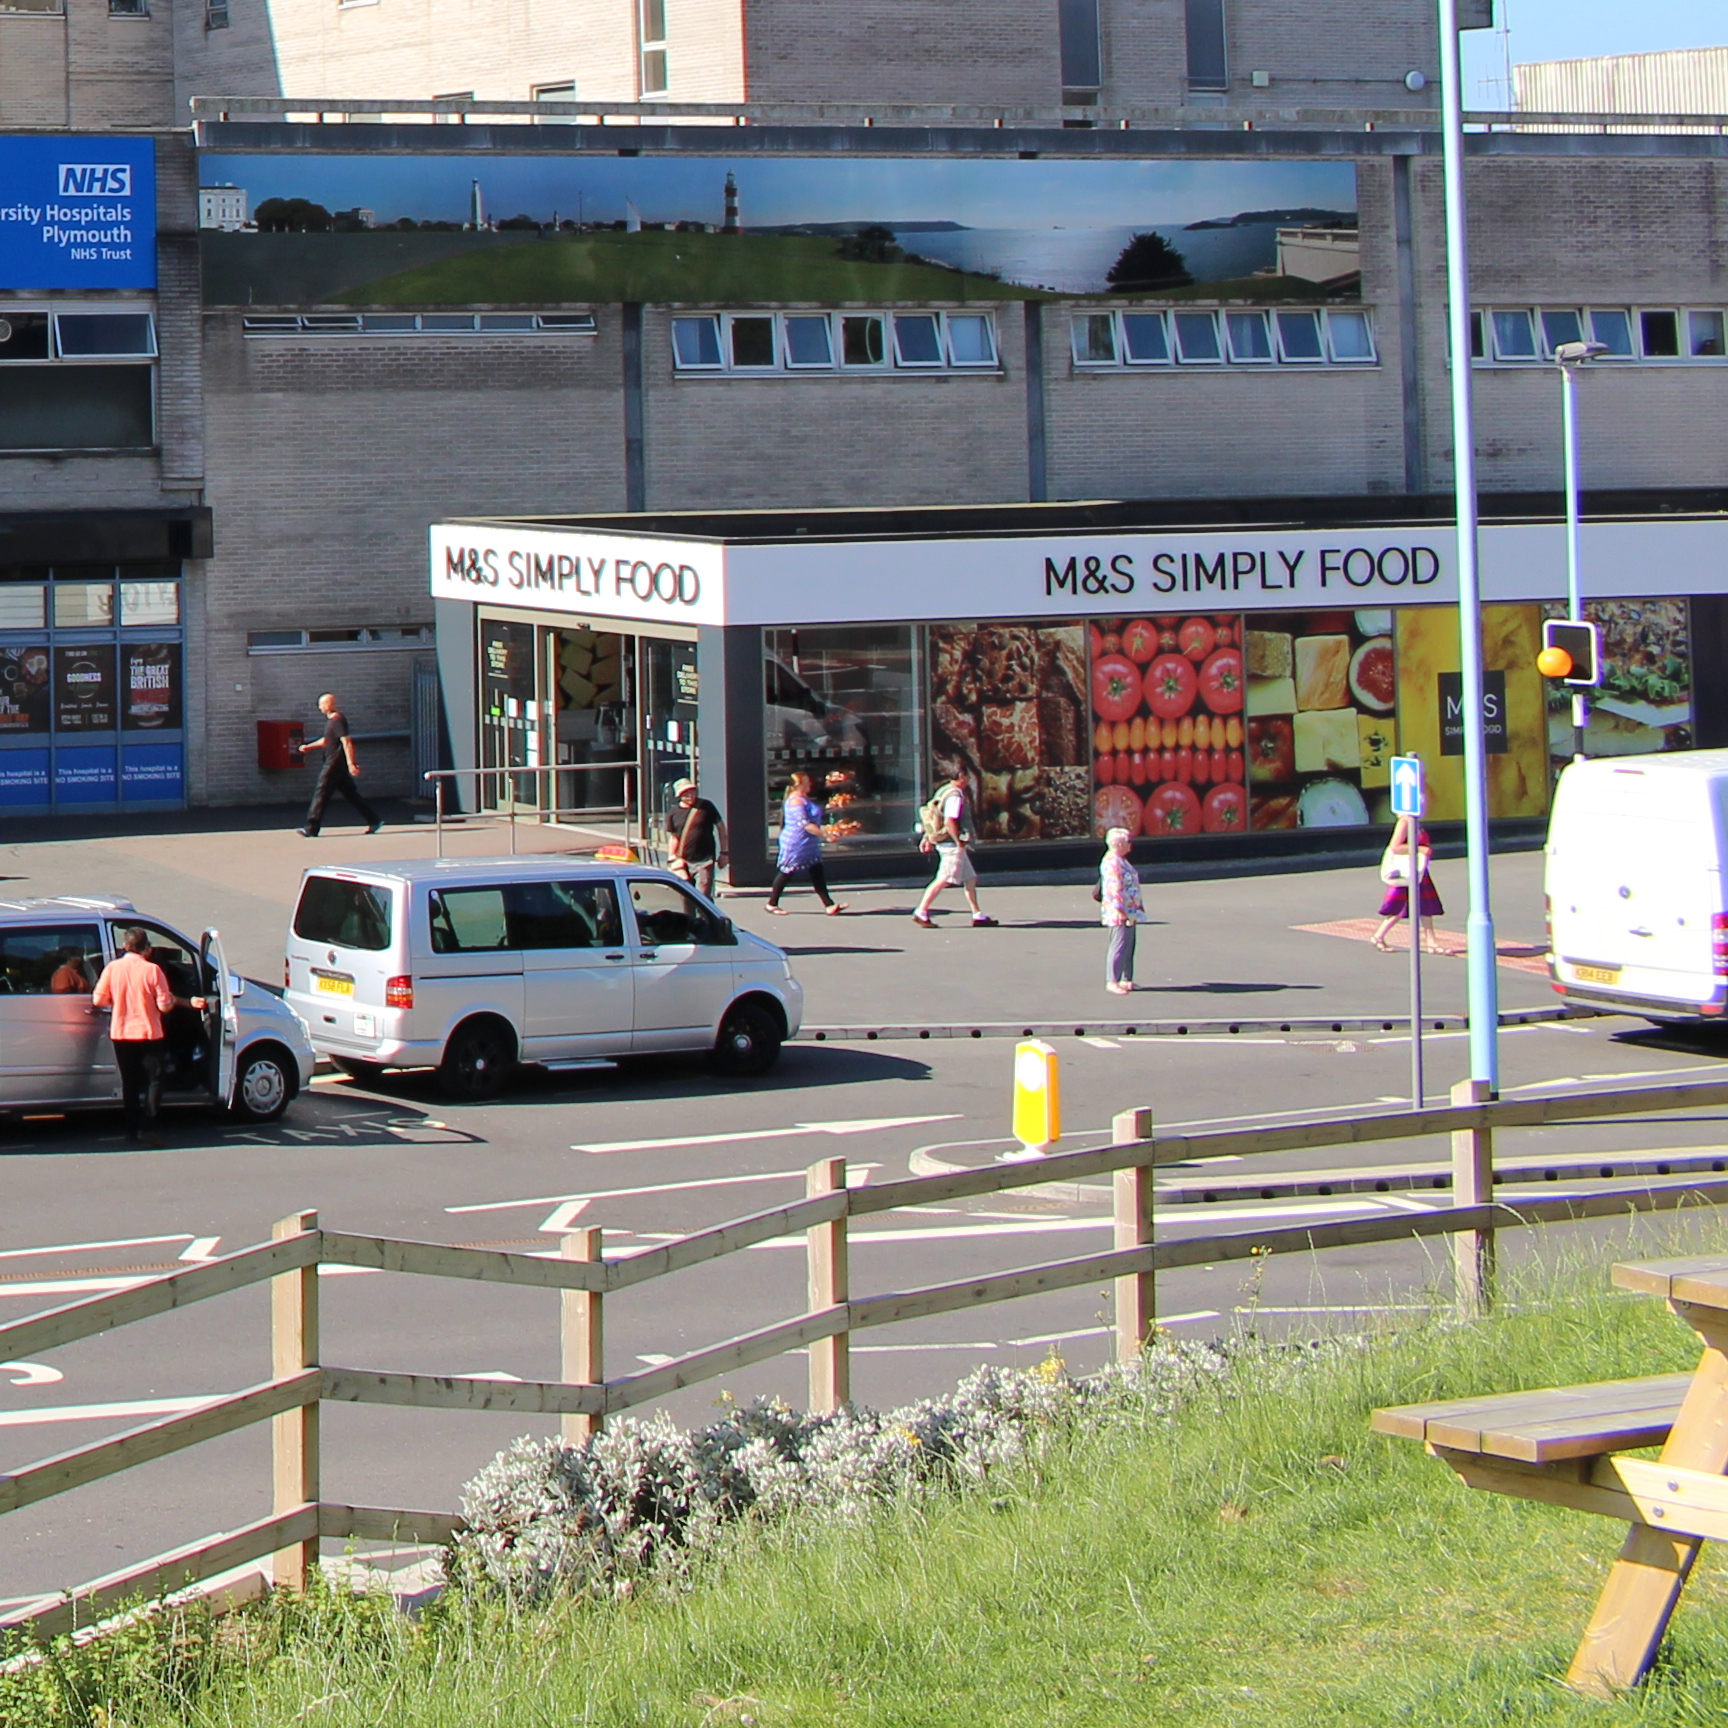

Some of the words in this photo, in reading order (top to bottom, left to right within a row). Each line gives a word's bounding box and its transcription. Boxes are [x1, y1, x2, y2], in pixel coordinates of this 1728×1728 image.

[61, 167, 127, 194] NHS
[46, 204, 132, 225] Hospitals
[43, 225, 132, 247] Plymouth
[71, 248, 98, 260] NHS
[101, 248, 132, 260] Trust
[445, 545, 499, 588] M&S
[508, 550, 606, 597] SIMPLY
[615, 558, 702, 606] FOOD
[1045, 554, 1135, 595] M&S
[1152, 550, 1305, 592] SIMPLY
[1320, 546, 1440, 588] FOOD
[130, 676, 169, 689] BRITISH
[1446, 693, 1497, 719] MS
